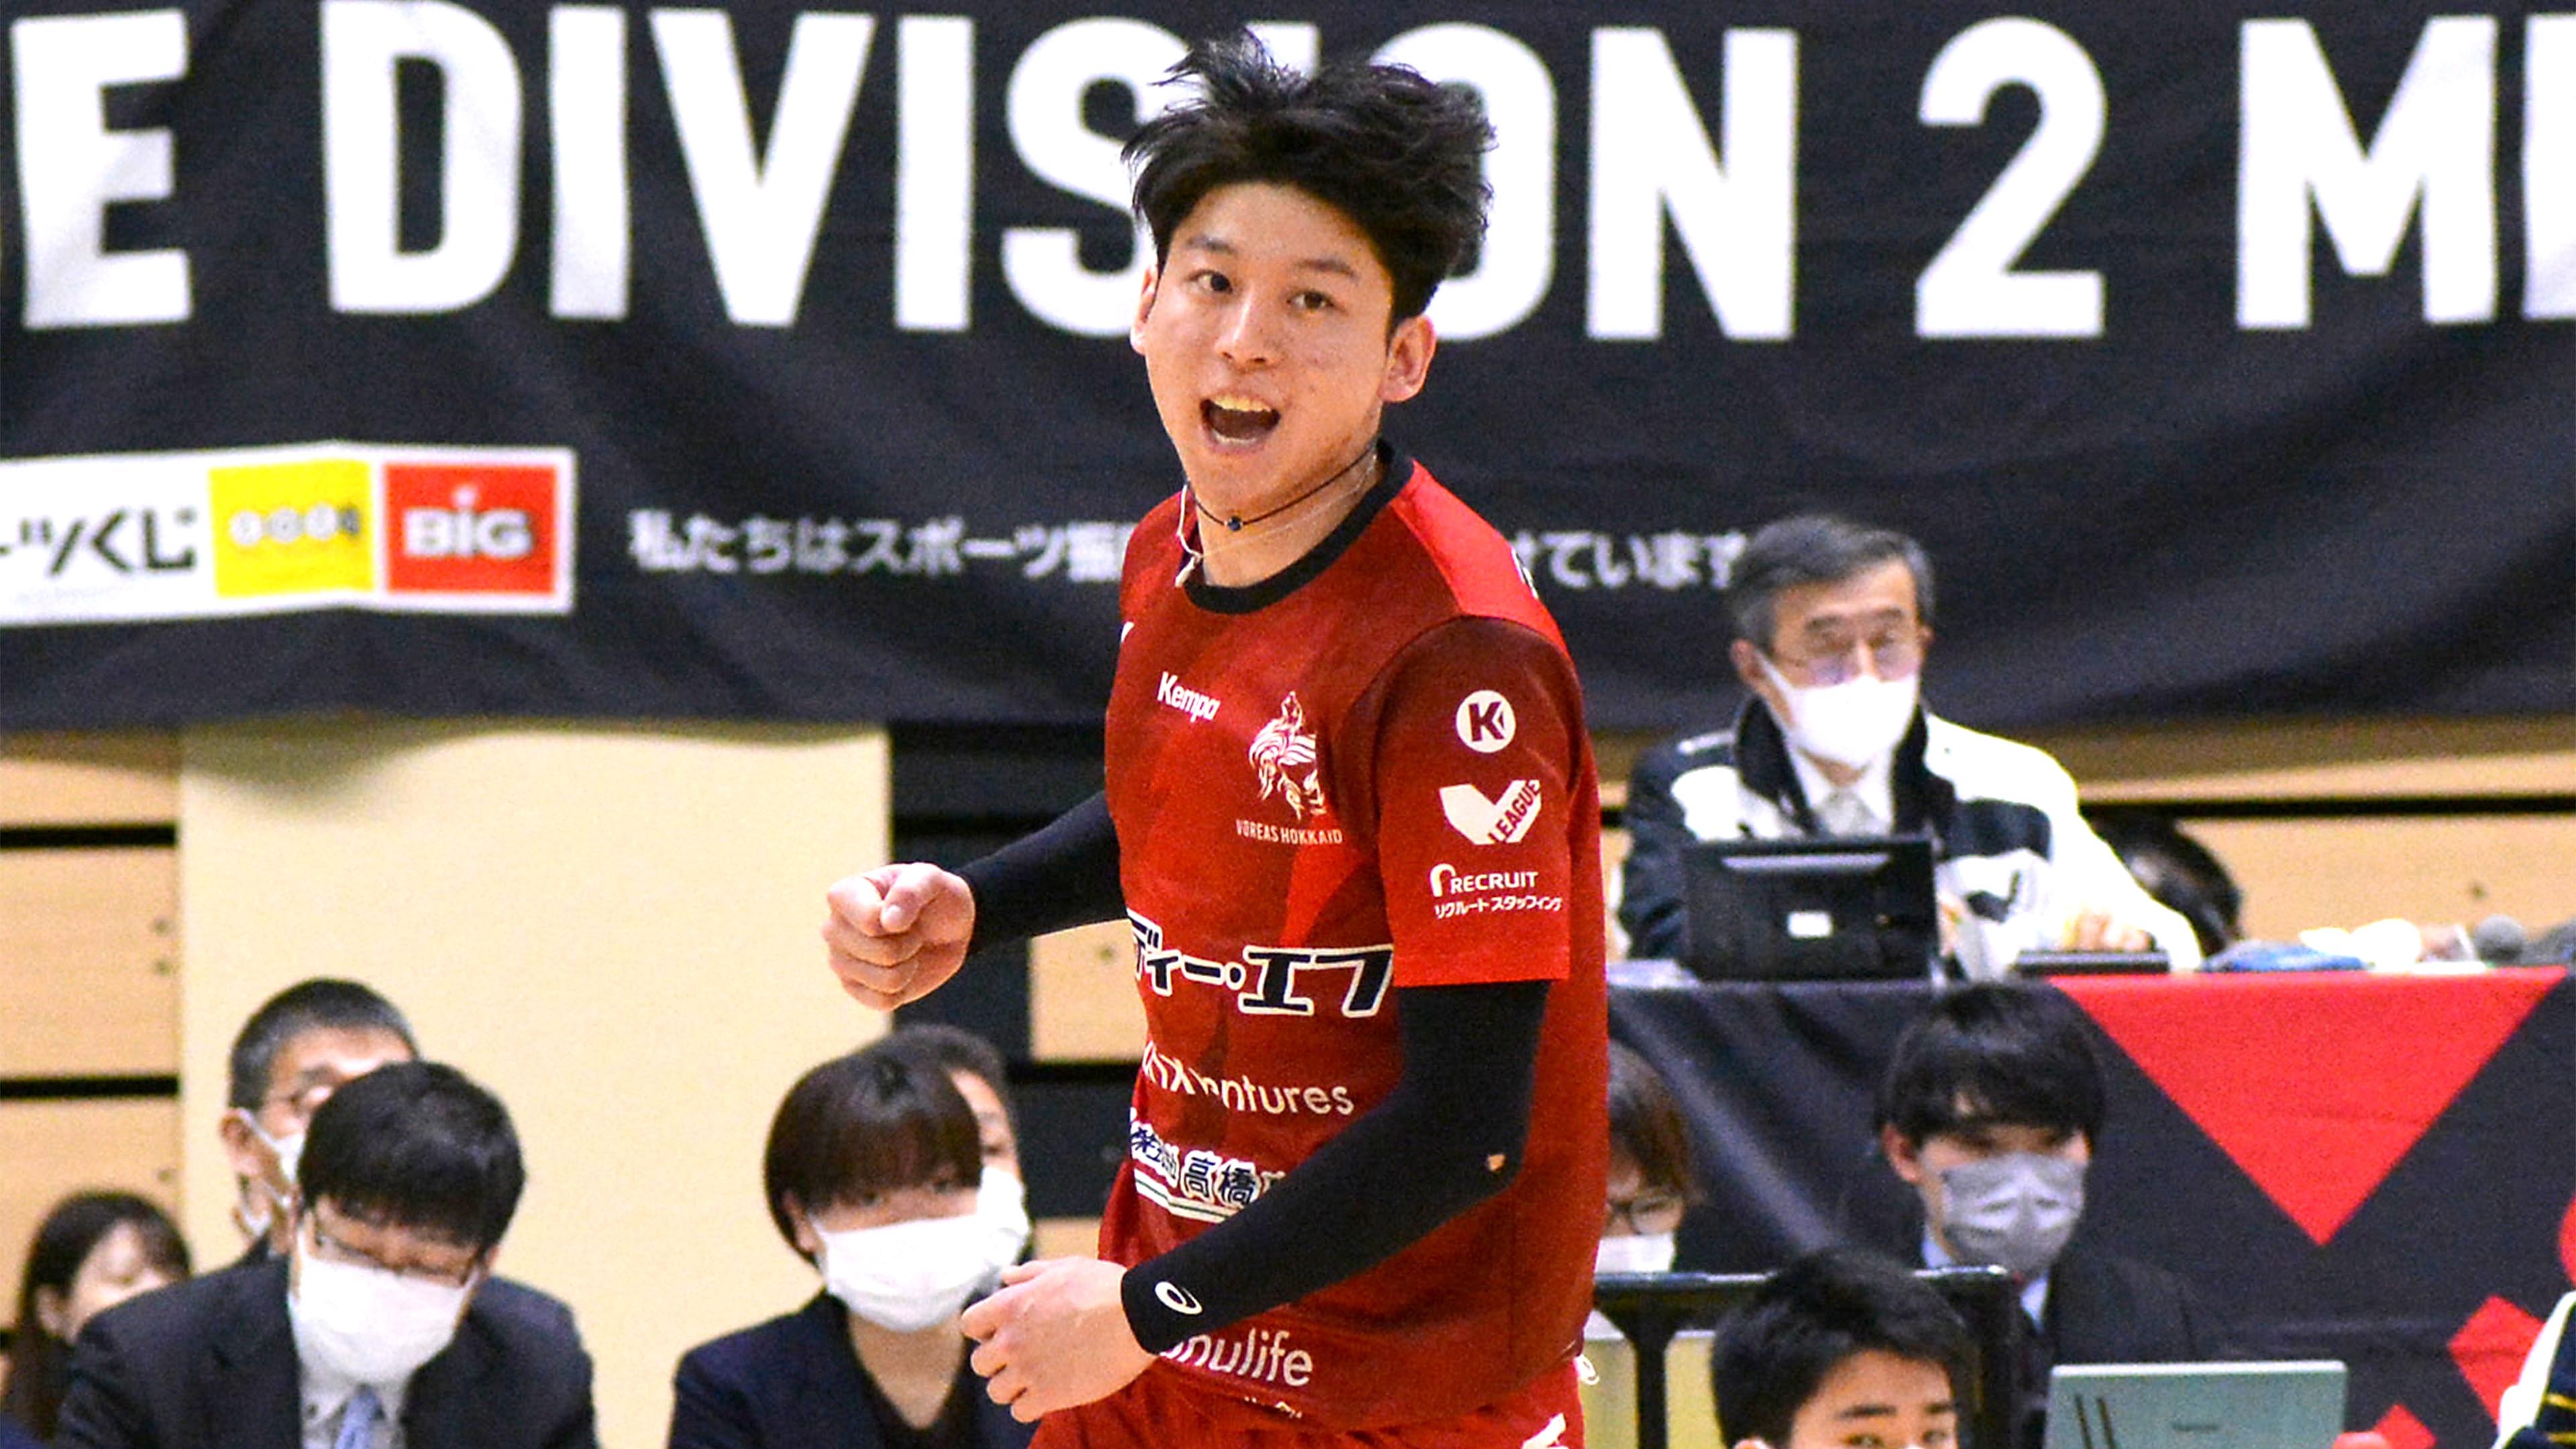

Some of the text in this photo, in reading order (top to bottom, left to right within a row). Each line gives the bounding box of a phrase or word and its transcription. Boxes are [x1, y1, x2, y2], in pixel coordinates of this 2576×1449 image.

[11, 9, 194, 330] E
[320, 0, 1799, 340] DIVISON
[1915, 16, 2106, 337] 2
[0, 507, 197, 576] ツくじ
[1157, 671, 1220, 722] Kempa
[1236, 818, 1279, 843] VOREAS
[1487, 780, 1542, 843] LEAGUE
[1450, 871, 1538, 894] RECRUIT
[1160, 1328, 1313, 1387] nulife
